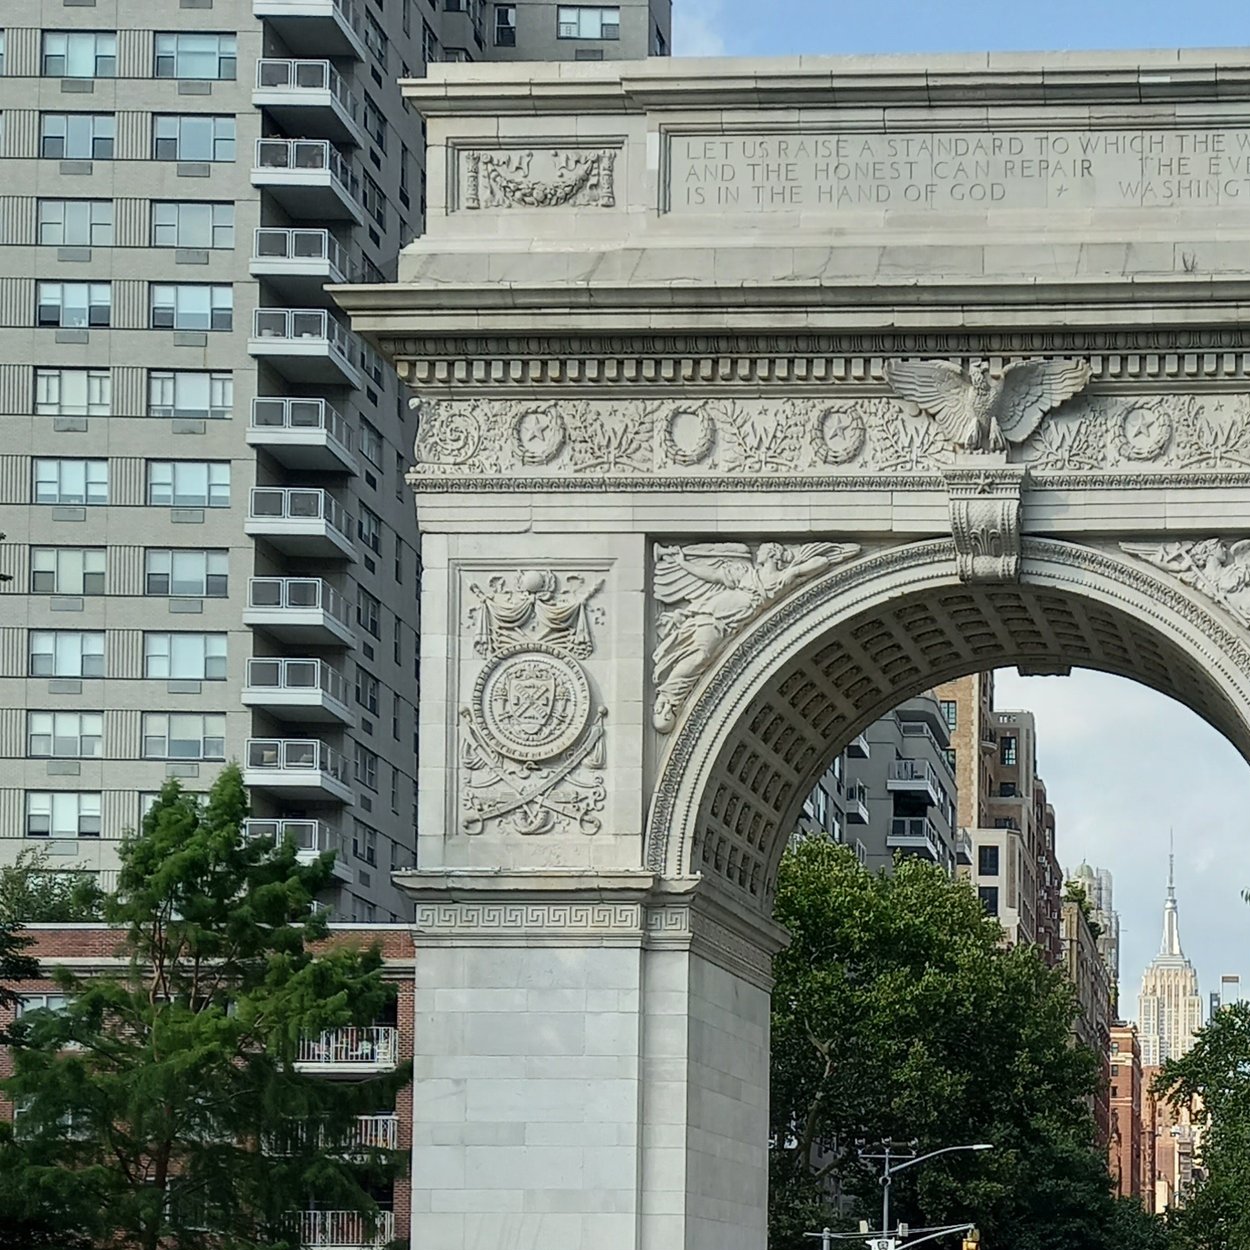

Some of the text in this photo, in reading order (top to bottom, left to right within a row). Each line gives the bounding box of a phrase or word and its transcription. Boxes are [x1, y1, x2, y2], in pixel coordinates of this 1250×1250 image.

[686, 140, 734, 160] LET
[742, 140, 770, 159] US
[778, 138, 849, 159] RAISE
[858, 138, 876, 157] A
[887, 136, 1024, 158] STANDARD
[1034, 136, 1069, 156] TO
[1078, 134, 1165, 155] WHICH
[1175, 133, 1226, 154] THE
[685, 163, 736, 183] AND
[747, 162, 800, 182] THE
[814, 160, 918, 181] HONEST
[933, 160, 990, 181] CAN
[1004, 158, 1095, 178] REPAIR
[1138, 156, 1191, 177] THE
[686, 186, 705, 206] IS
[717, 185, 739, 206] IN
[751, 184, 803, 205] THE
[817, 183, 891, 204] HAND
[903, 183, 938, 203] OF
[949, 182, 1006, 202] GOD
